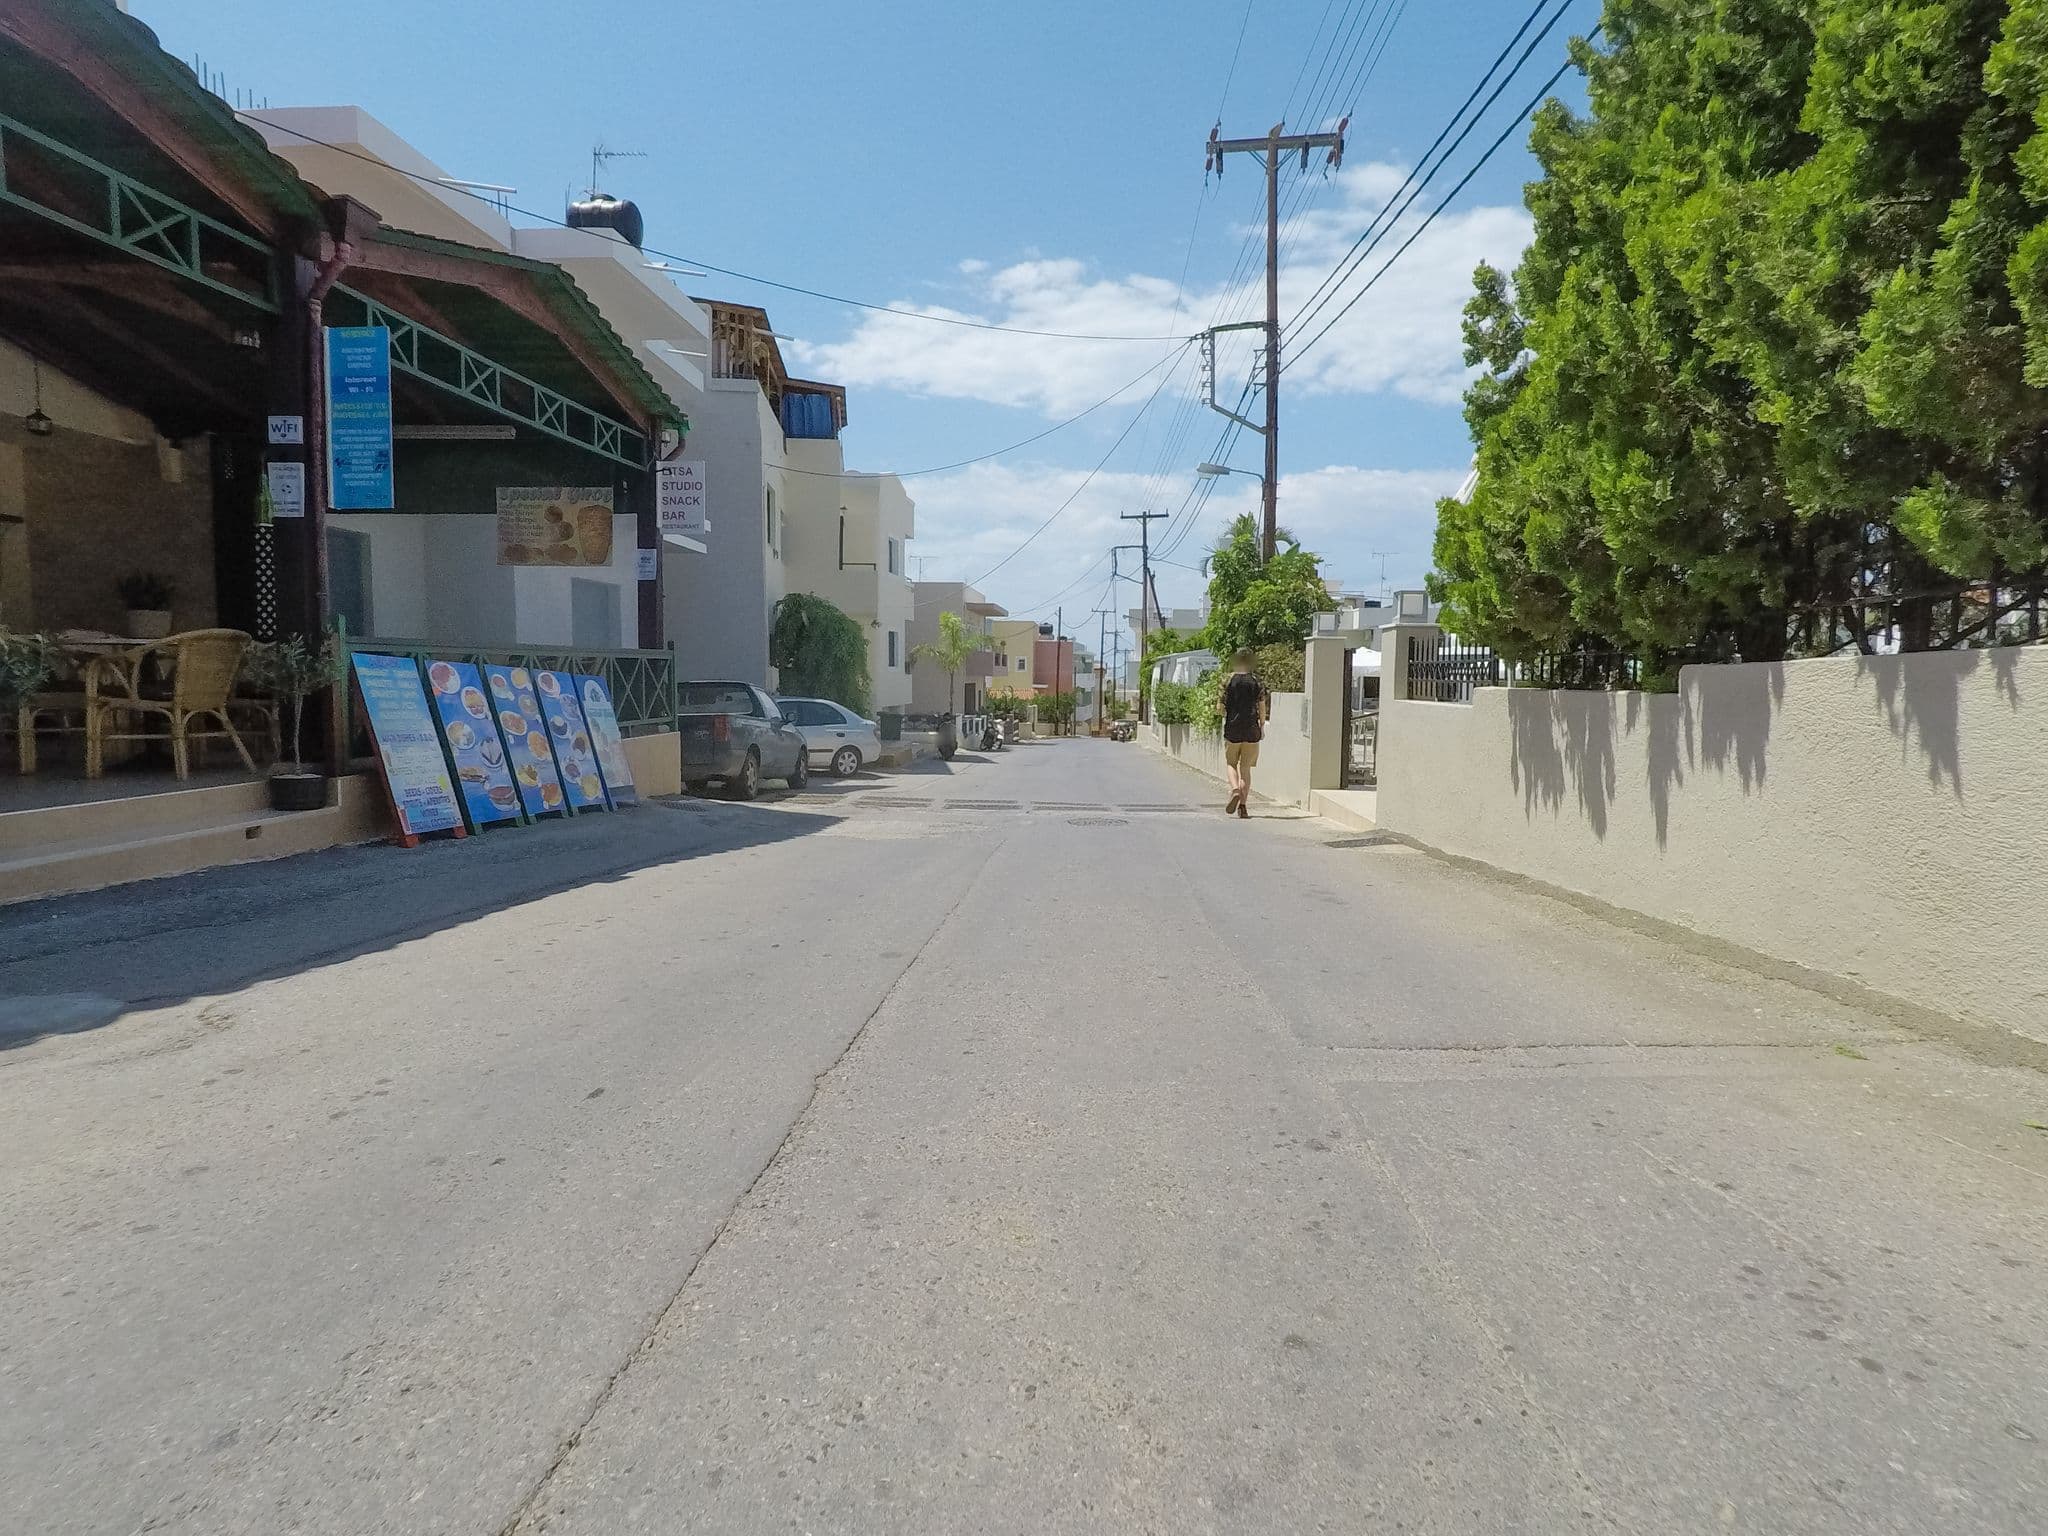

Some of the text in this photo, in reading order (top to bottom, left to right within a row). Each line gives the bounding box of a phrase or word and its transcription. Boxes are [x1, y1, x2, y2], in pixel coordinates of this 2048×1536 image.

[271, 422, 298, 433] WIFI
[662, 481, 703, 491] STUDIO
[662, 496, 700, 506] SNACK
[662, 511, 686, 521] BAR
